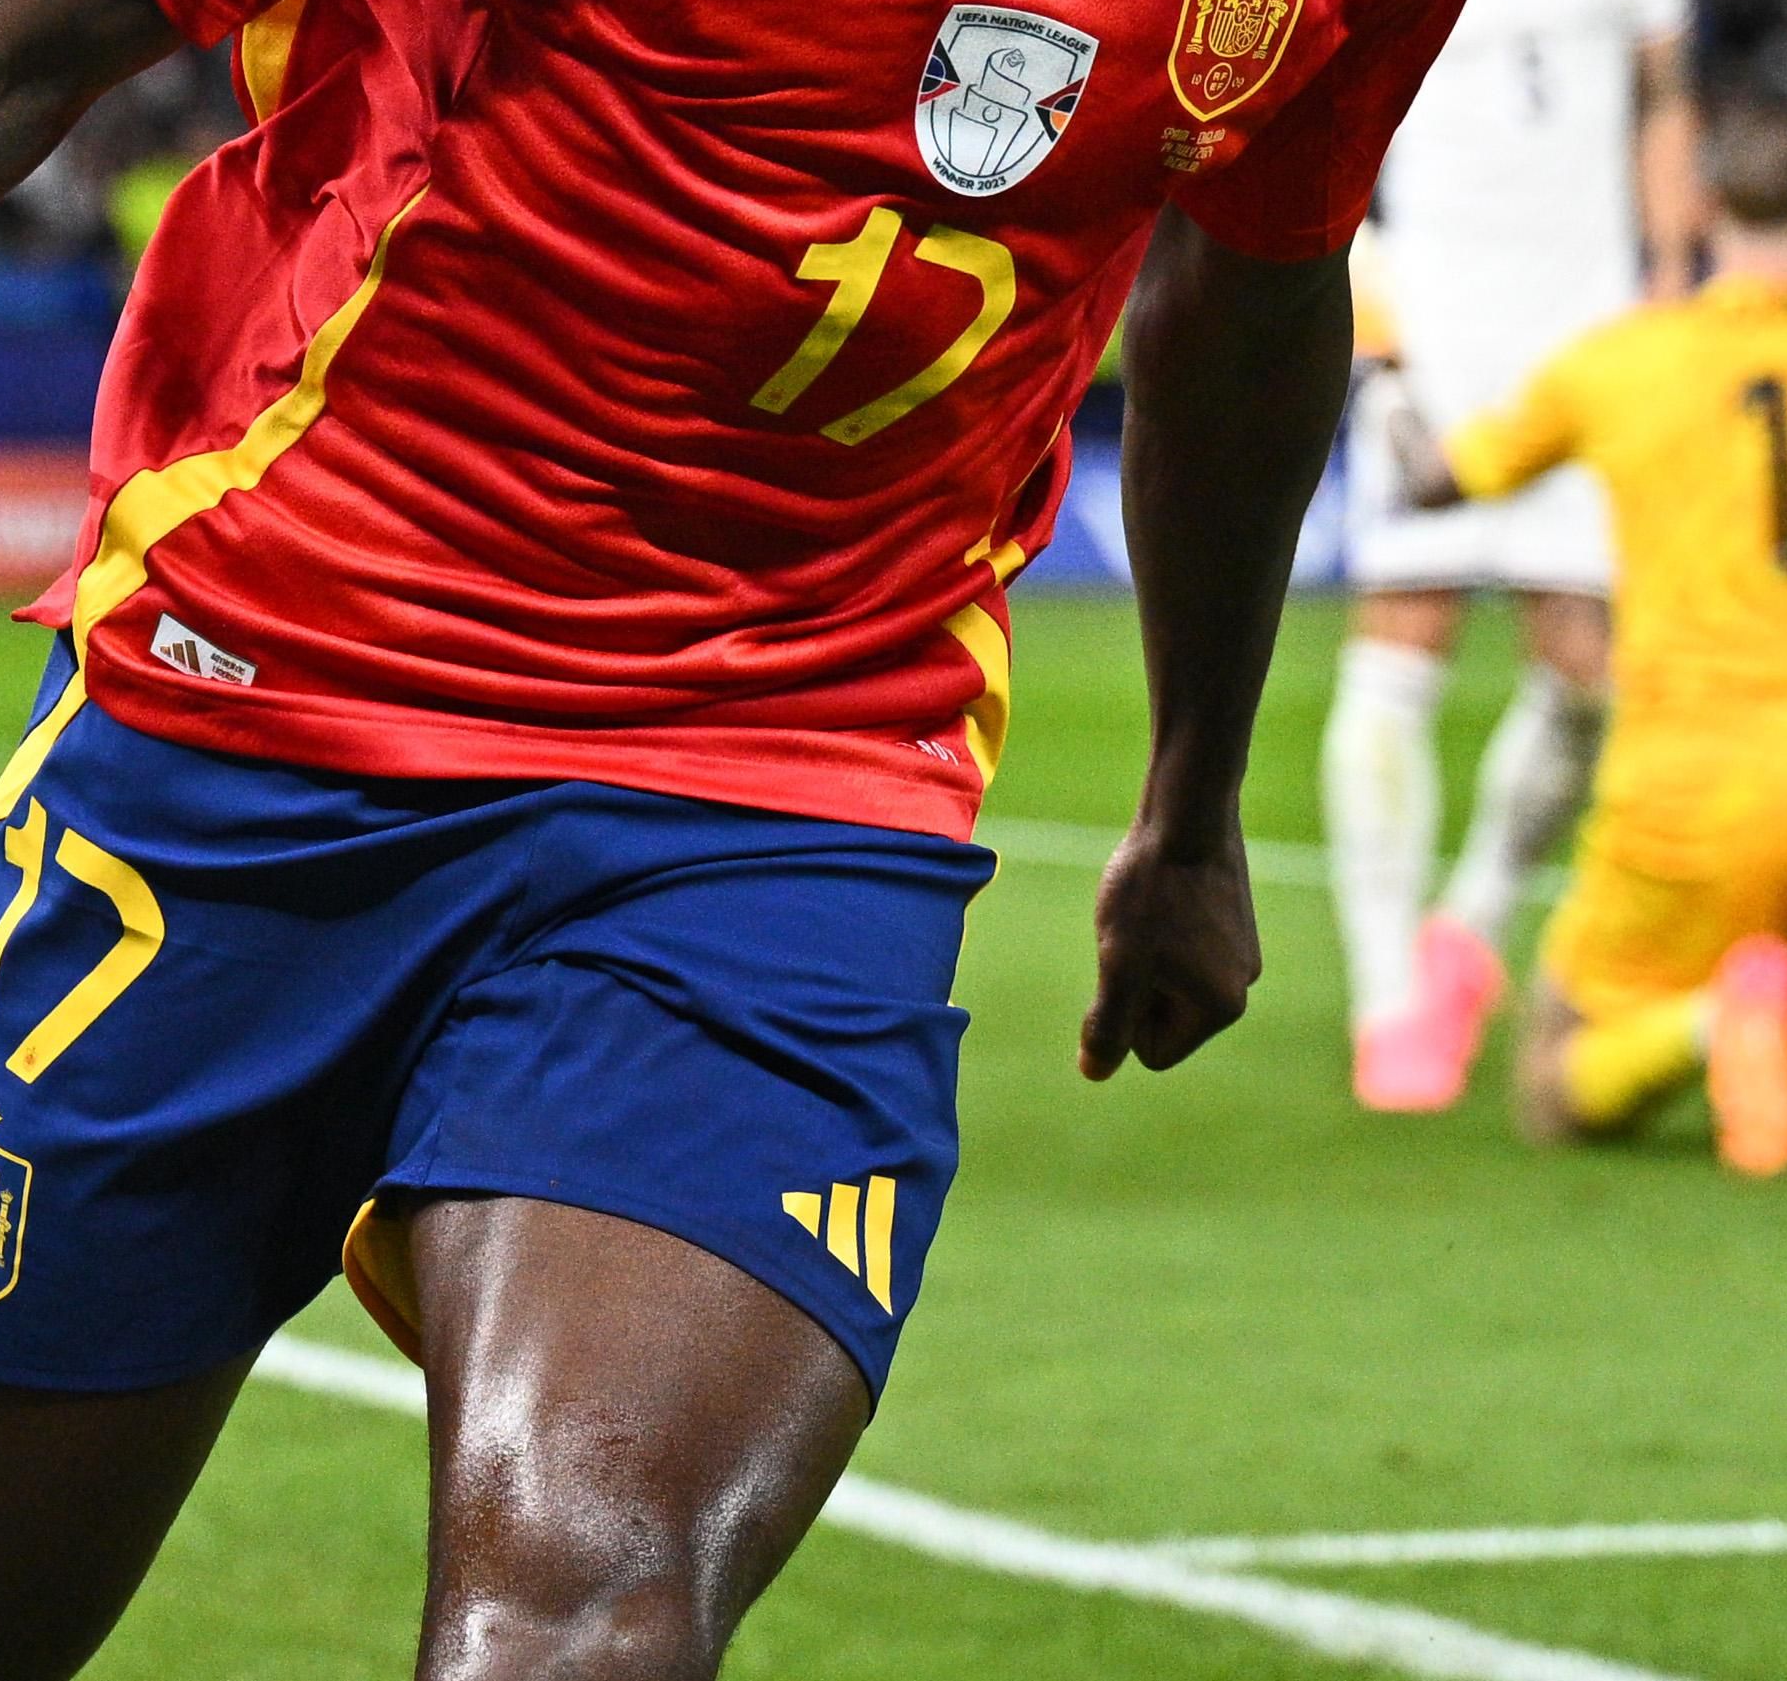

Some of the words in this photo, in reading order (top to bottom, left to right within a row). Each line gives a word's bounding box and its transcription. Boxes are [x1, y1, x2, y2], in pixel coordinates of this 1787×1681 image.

[955, 12, 988, 23] UEFA
[989, 15, 1046, 35] NATIONS
[1045, 28, 1091, 55] LEAGUE
[1209, 82, 1224, 92] EF
[1212, 71, 1228, 81] RF
[933, 156, 975, 190] WINNER
[977, 176, 1007, 190] 2023
[749, 206, 1016, 447] 17
